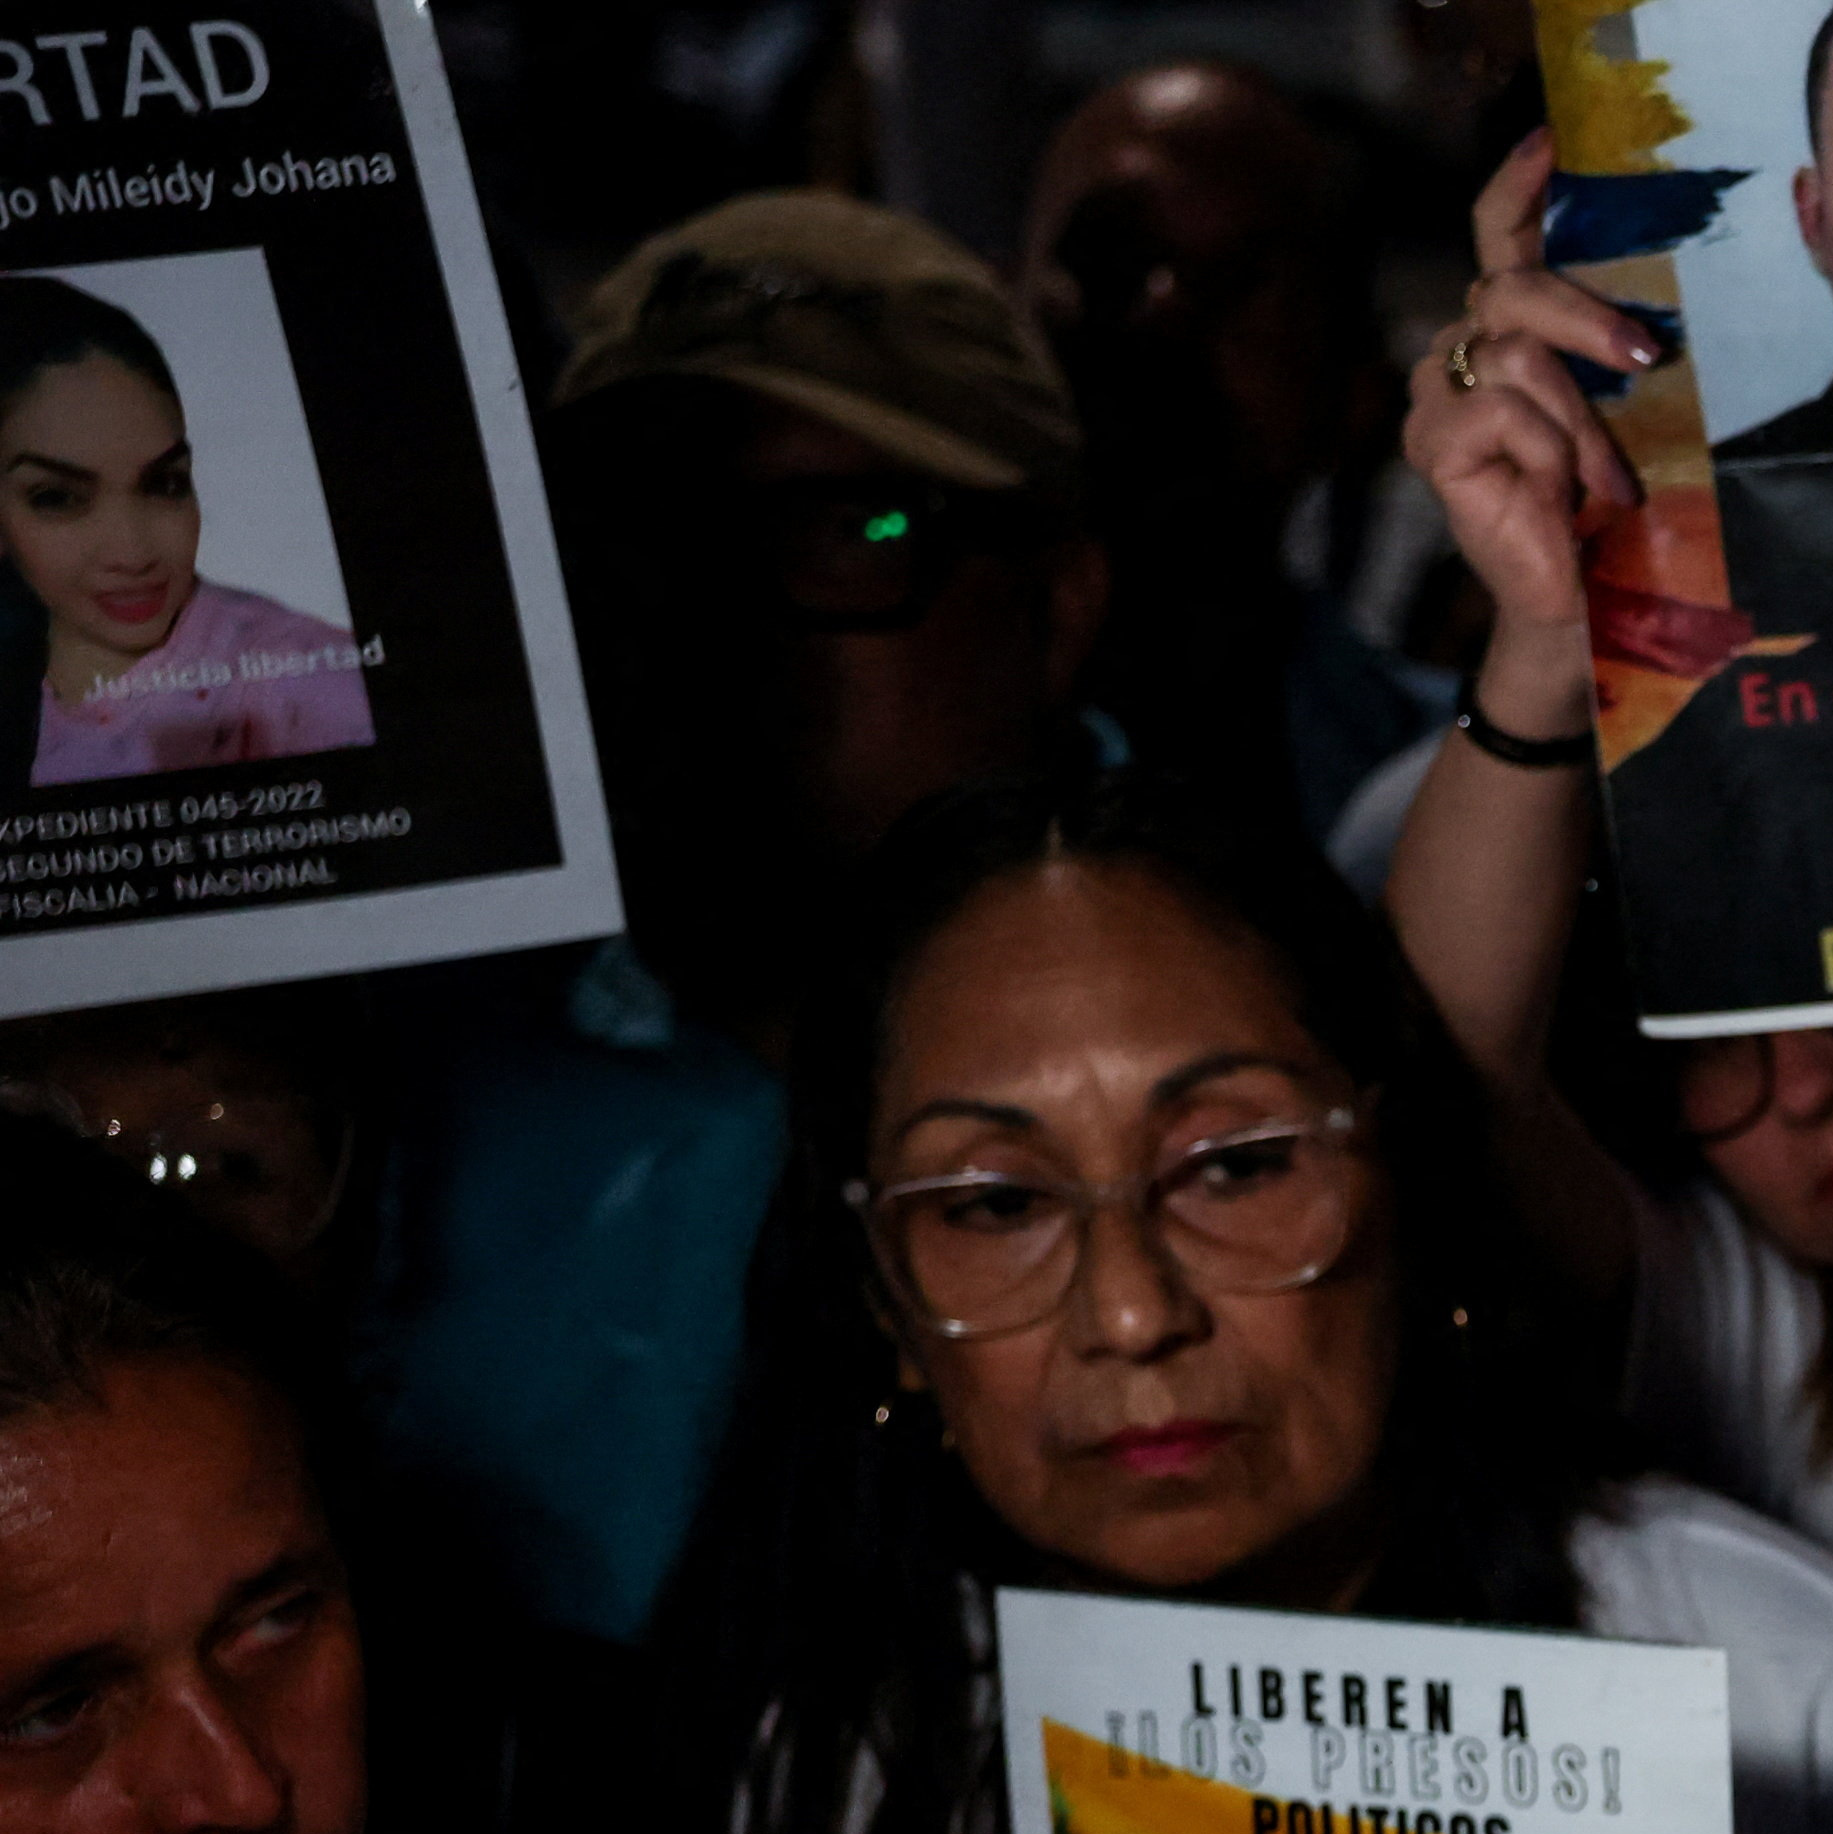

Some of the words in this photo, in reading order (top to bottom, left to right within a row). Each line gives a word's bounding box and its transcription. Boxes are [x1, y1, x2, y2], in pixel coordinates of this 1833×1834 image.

[230, 149, 398, 200] Johana
[1738, 671, 1819, 729] En
[179, 778, 324, 826] 045-2022
[151, 833, 198, 868] DE
[201, 806, 413, 860] TERRORISMO
[173, 856, 339, 902] NACIONAL
[1191, 1663, 1454, 1735] LIBEREN
[1501, 1685, 1528, 1739] A
[1309, 1721, 1624, 1817] PRESOS!
